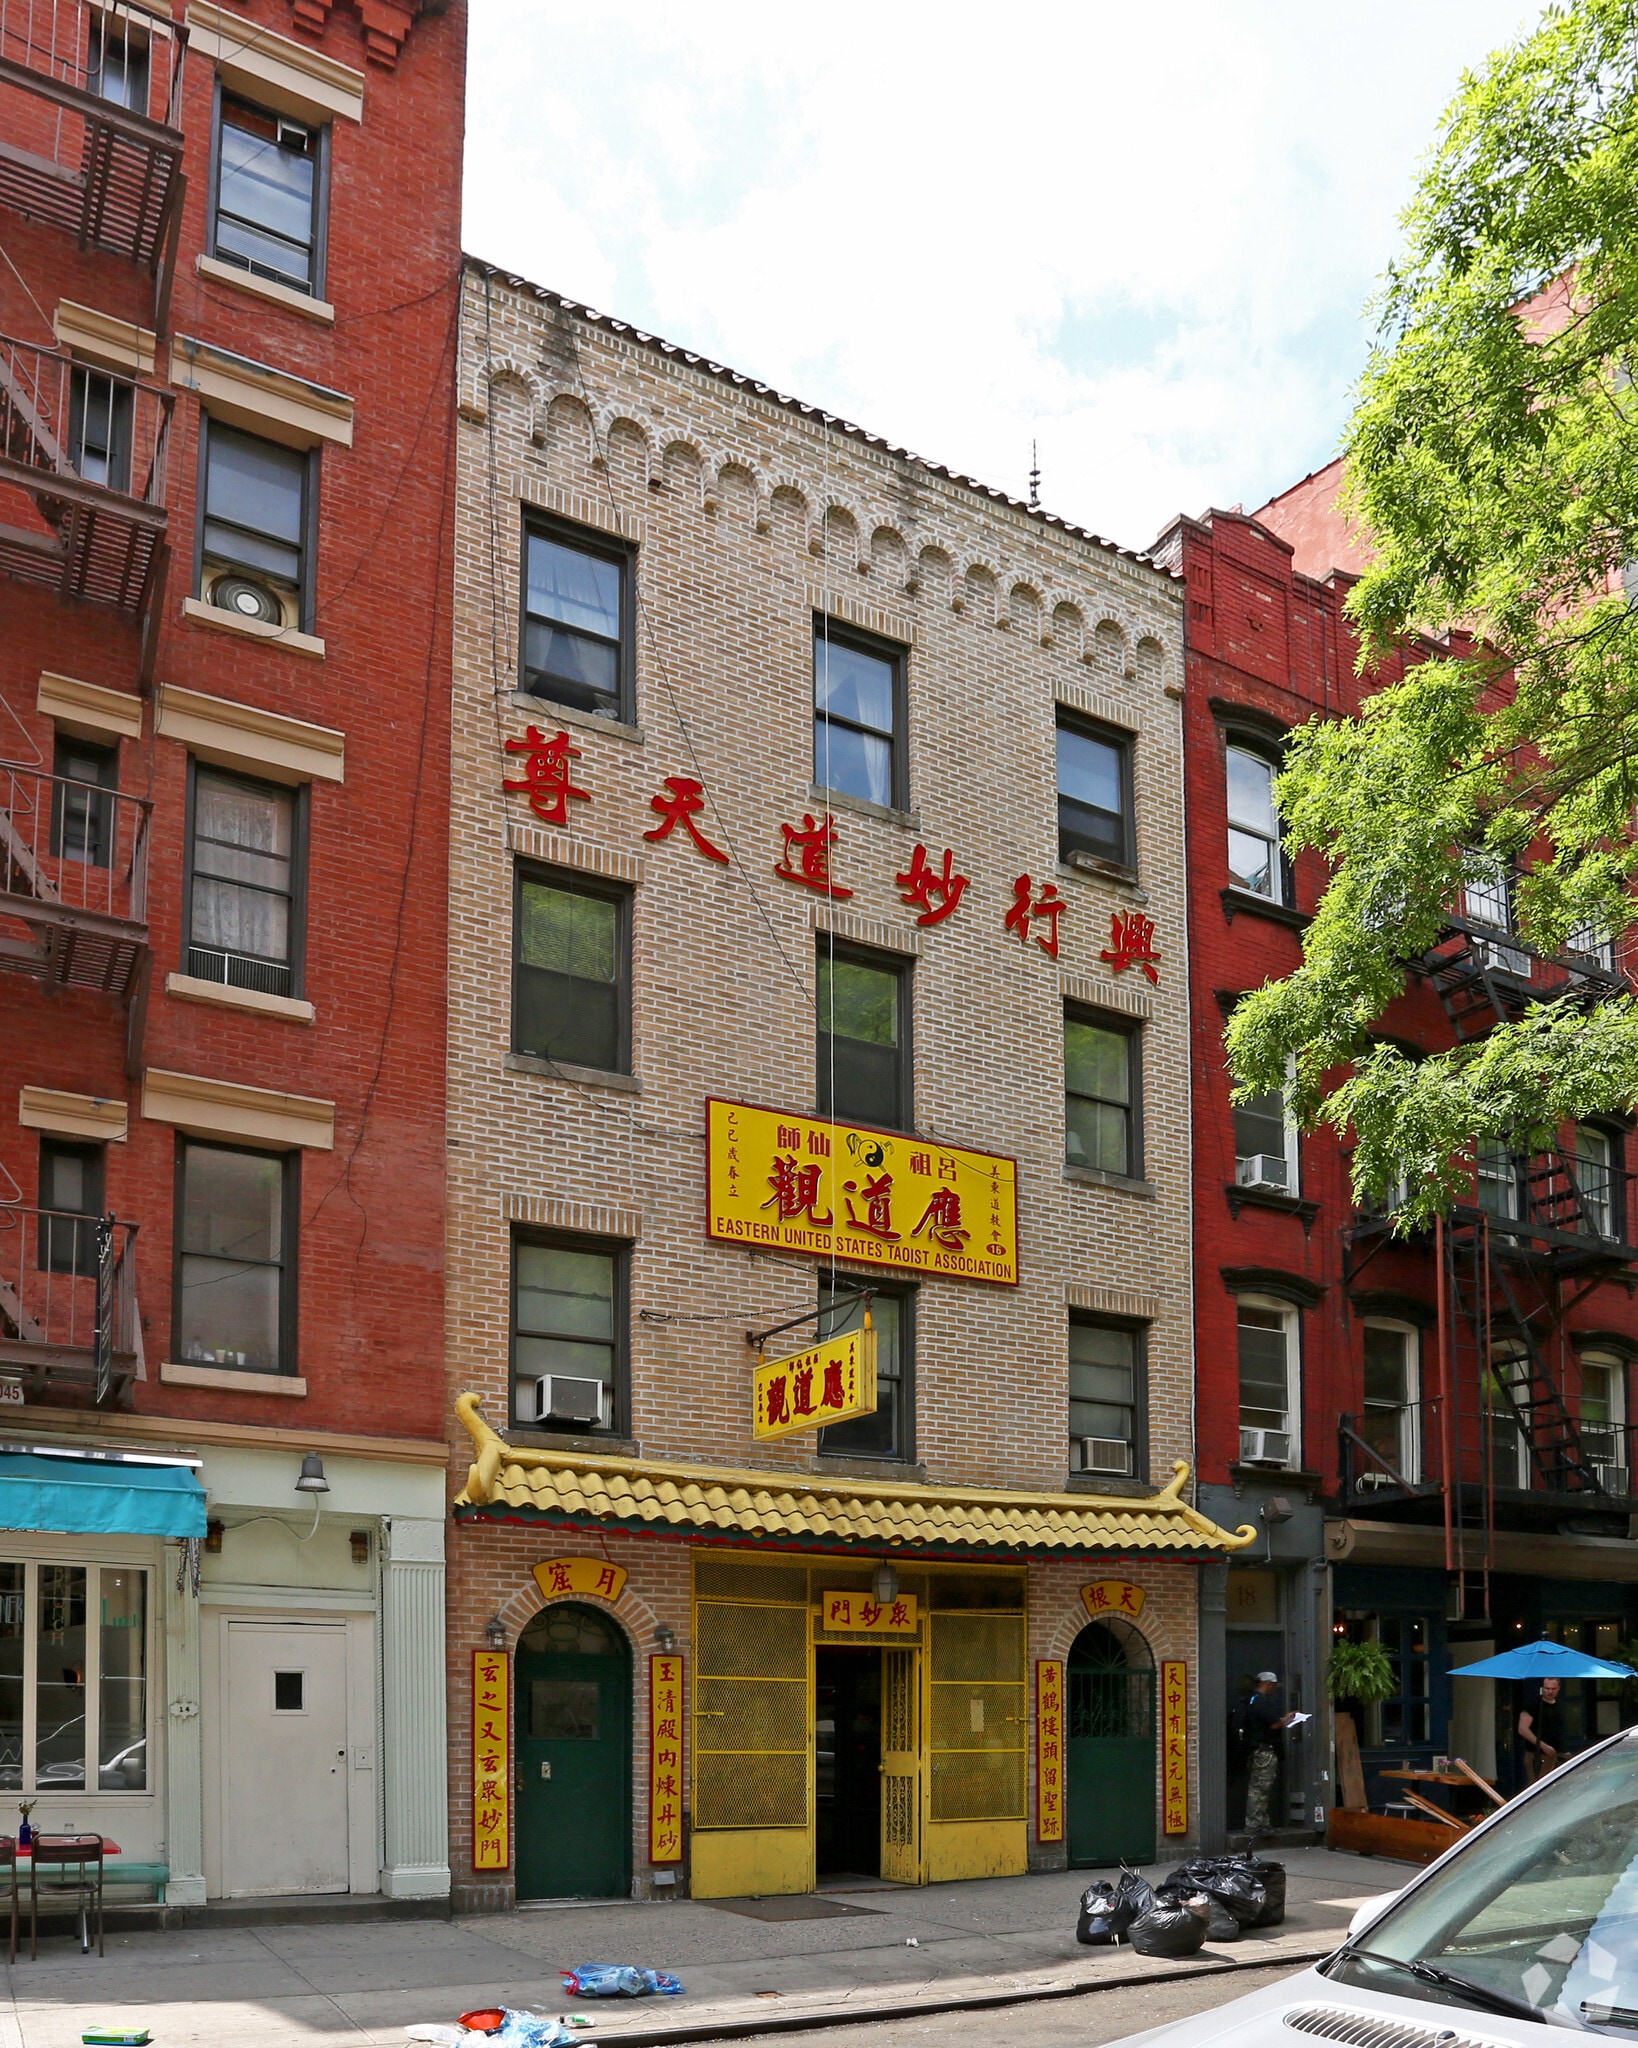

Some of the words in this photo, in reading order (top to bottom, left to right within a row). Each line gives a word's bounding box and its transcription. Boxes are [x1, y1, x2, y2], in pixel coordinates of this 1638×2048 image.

[717, 1217, 780, 1242] EASTERN
[784, 1227, 831, 1250] UNITED
[836, 1236, 882, 1259] STATES
[887, 1245, 930, 1265] TAOIST
[934, 1253, 1012, 1279] ASSOCIATION
[990, 1244, 1002, 1256] 16
[1238, 1584, 1256, 1606] 18
